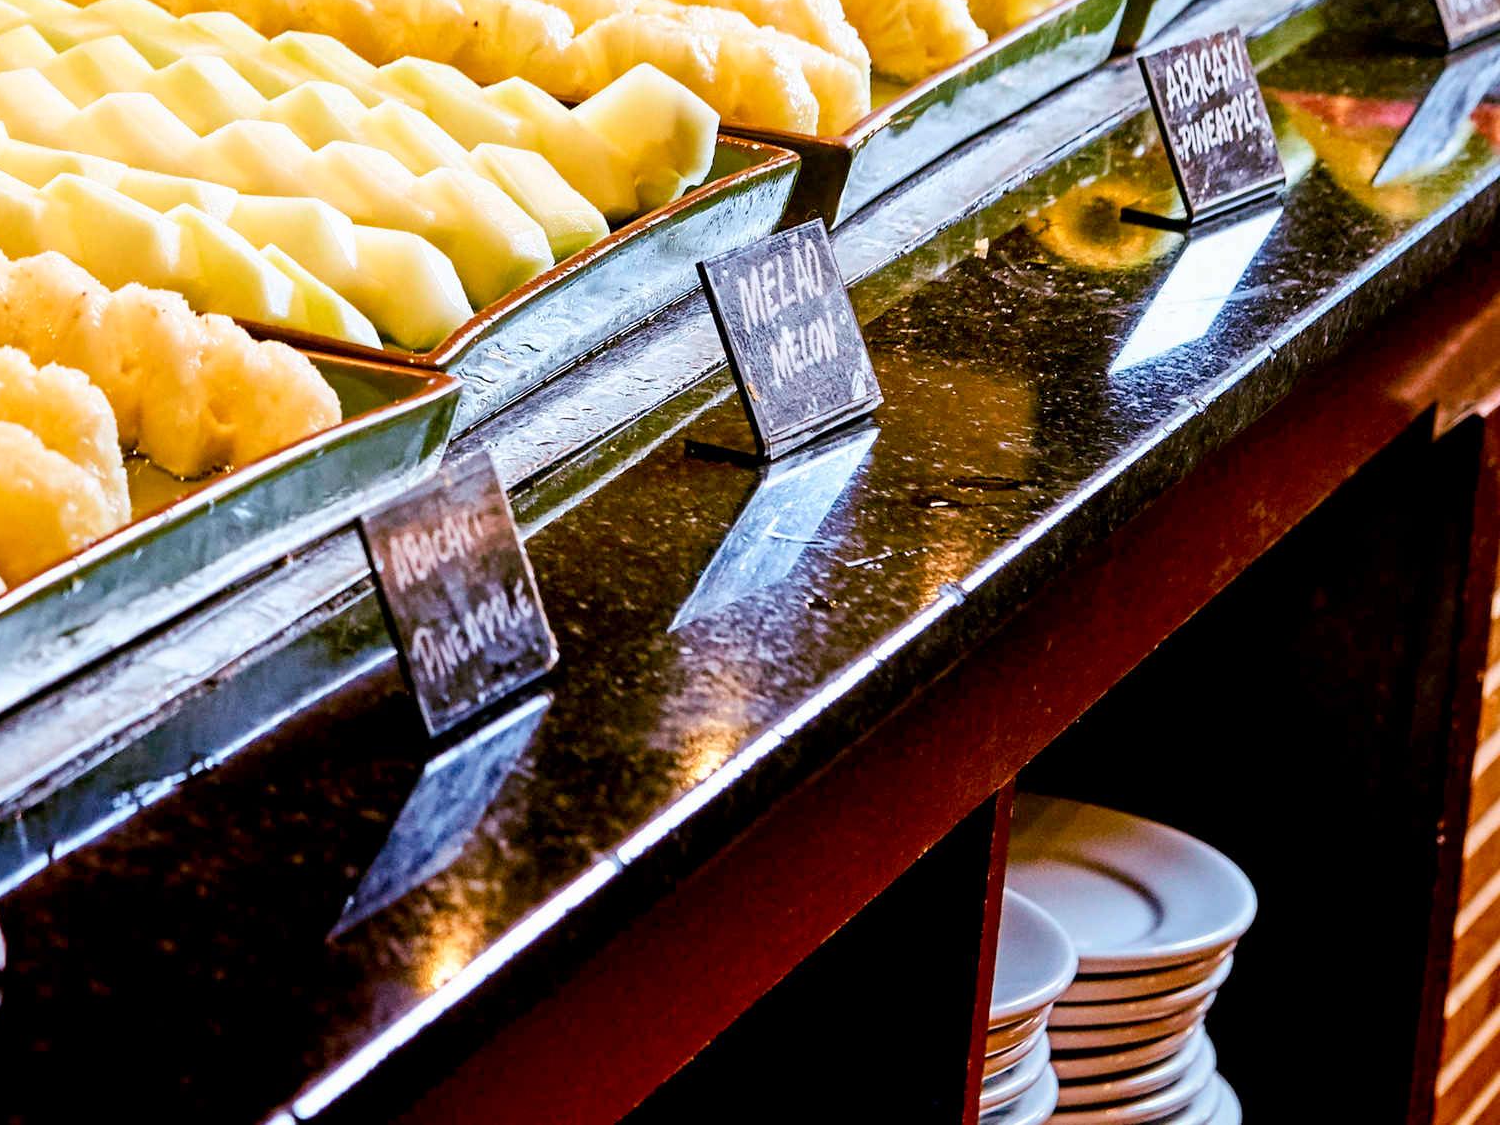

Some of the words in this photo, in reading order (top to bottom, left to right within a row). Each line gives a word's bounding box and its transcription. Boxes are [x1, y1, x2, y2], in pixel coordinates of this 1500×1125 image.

[1165, 38, 1245, 113] ABACAXI
[1179, 88, 1261, 162] PINEAPPLE
[770, 311, 838, 389] MELON
